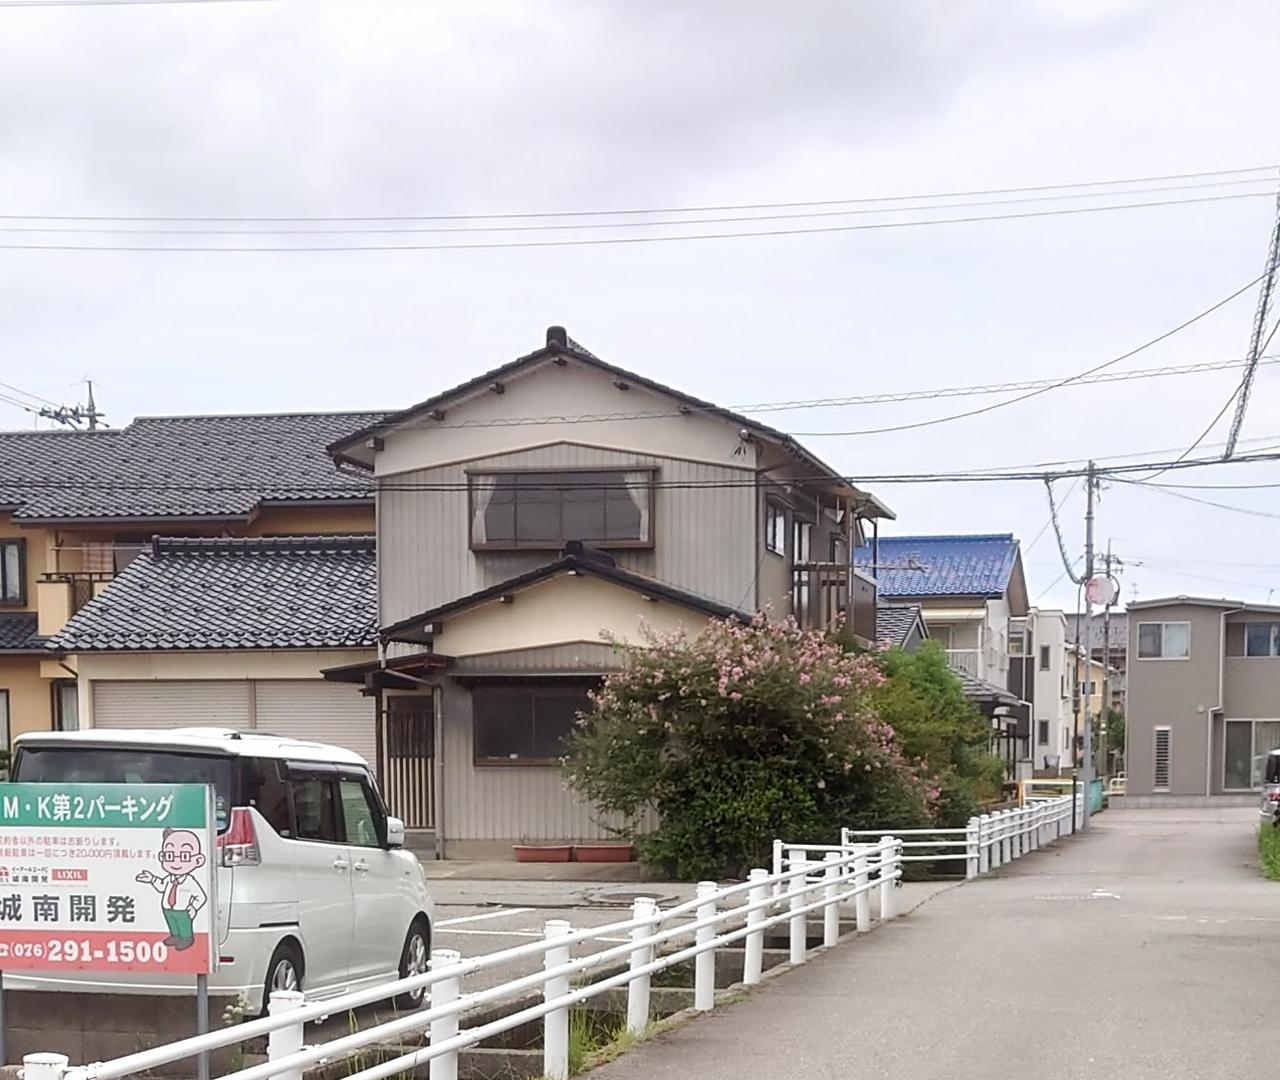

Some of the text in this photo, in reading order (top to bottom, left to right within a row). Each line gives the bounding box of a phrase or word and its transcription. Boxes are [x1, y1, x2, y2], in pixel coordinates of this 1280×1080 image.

[3, 793, 174, 822] M・K第2パーキング
[57, 870, 83, 879] LIXIL
